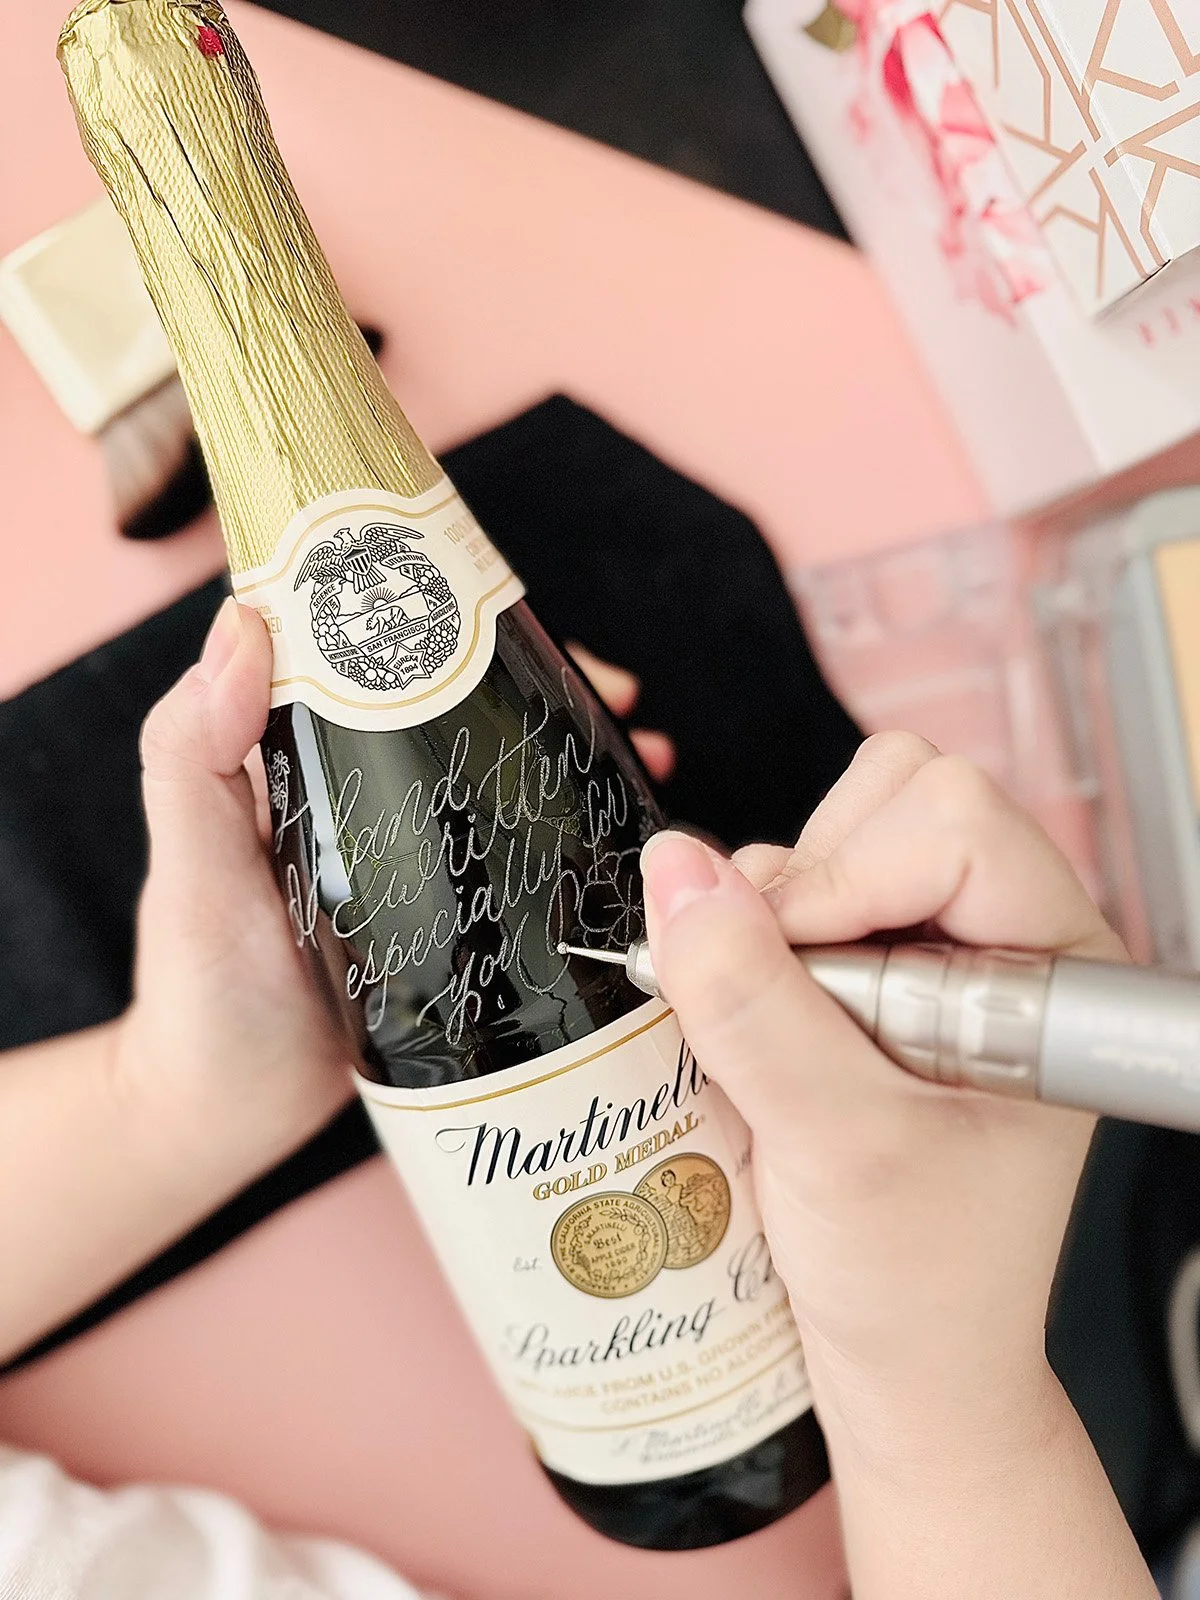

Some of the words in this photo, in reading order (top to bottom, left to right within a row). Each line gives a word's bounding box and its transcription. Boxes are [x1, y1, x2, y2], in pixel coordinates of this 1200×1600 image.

[384, 554, 426, 567] LITERATURE
[313, 583, 337, 609] SCIENCE
[366, 641, 384, 653] SAN
[383, 622, 427, 643] FRANCISCO
[393, 653, 419, 670] EUREKA
[400, 662, 419, 675] 1894
[333, 726, 471, 881] hand
[346, 818, 581, 1032] especially
[416, 910, 571, 1046] you
[532, 1161, 608, 1200] GOLD
[614, 1110, 699, 1174] MEDAL
[559, 1205, 593, 1245] CALIFORNIA
[593, 1198, 621, 1210] STATE
[622, 1200, 661, 1249] AGRICULTURAL
[593, 1231, 623, 1250] Best
[505, 1297, 727, 1373] Sparkling
[695, 1366, 724, 1387] NO
